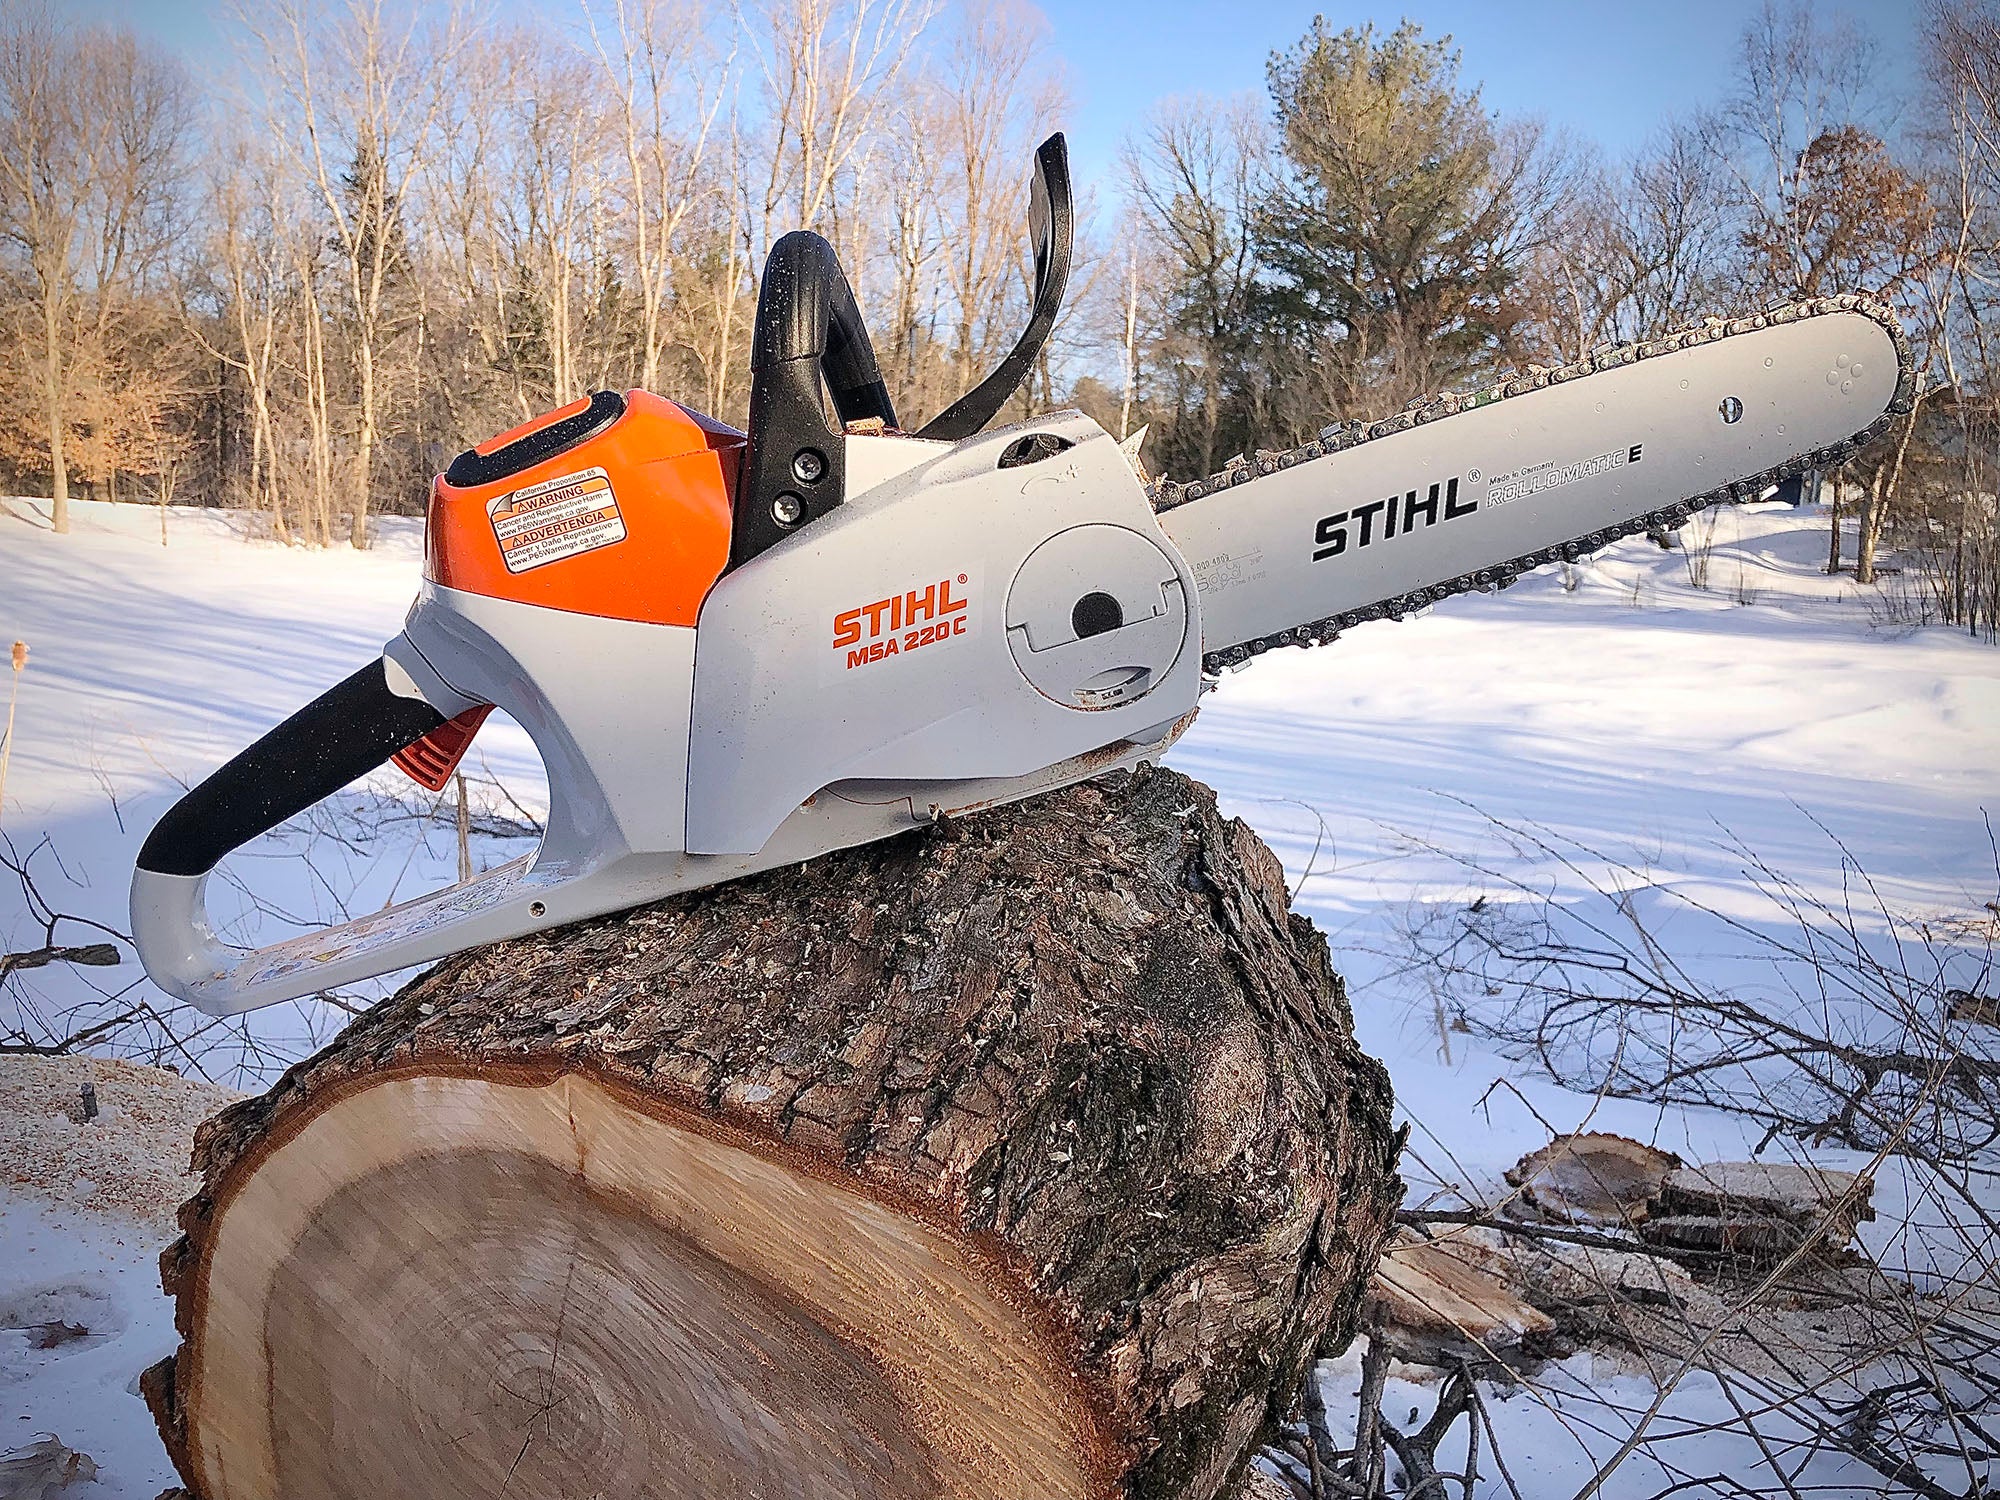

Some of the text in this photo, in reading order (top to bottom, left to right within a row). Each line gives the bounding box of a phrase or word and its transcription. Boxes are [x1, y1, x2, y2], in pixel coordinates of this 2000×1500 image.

[515, 468, 596, 499] California Proposition 65
[1487, 443, 1643, 507] ROLLOMATIC E
[1489, 460, 1555, 486] Made in Germany
[496, 516, 522, 531] Cancer
[523, 510, 536, 523] and
[536, 498, 583, 519] Reproductive
[583, 491, 603, 505] Harm
[527, 485, 584, 510] WARNING
[523, 511, 606, 544] ADVERTENCIA
[1312, 476, 1479, 563] STIHL
[507, 545, 534, 560] Cáncer
[536, 544, 540, 552] y
[541, 536, 562, 549] Daño
[563, 521, 613, 542] Reproductivo
[833, 579, 968, 649] STIHL
[847, 638, 900, 670] MSA
[904, 621, 950, 651] 220
